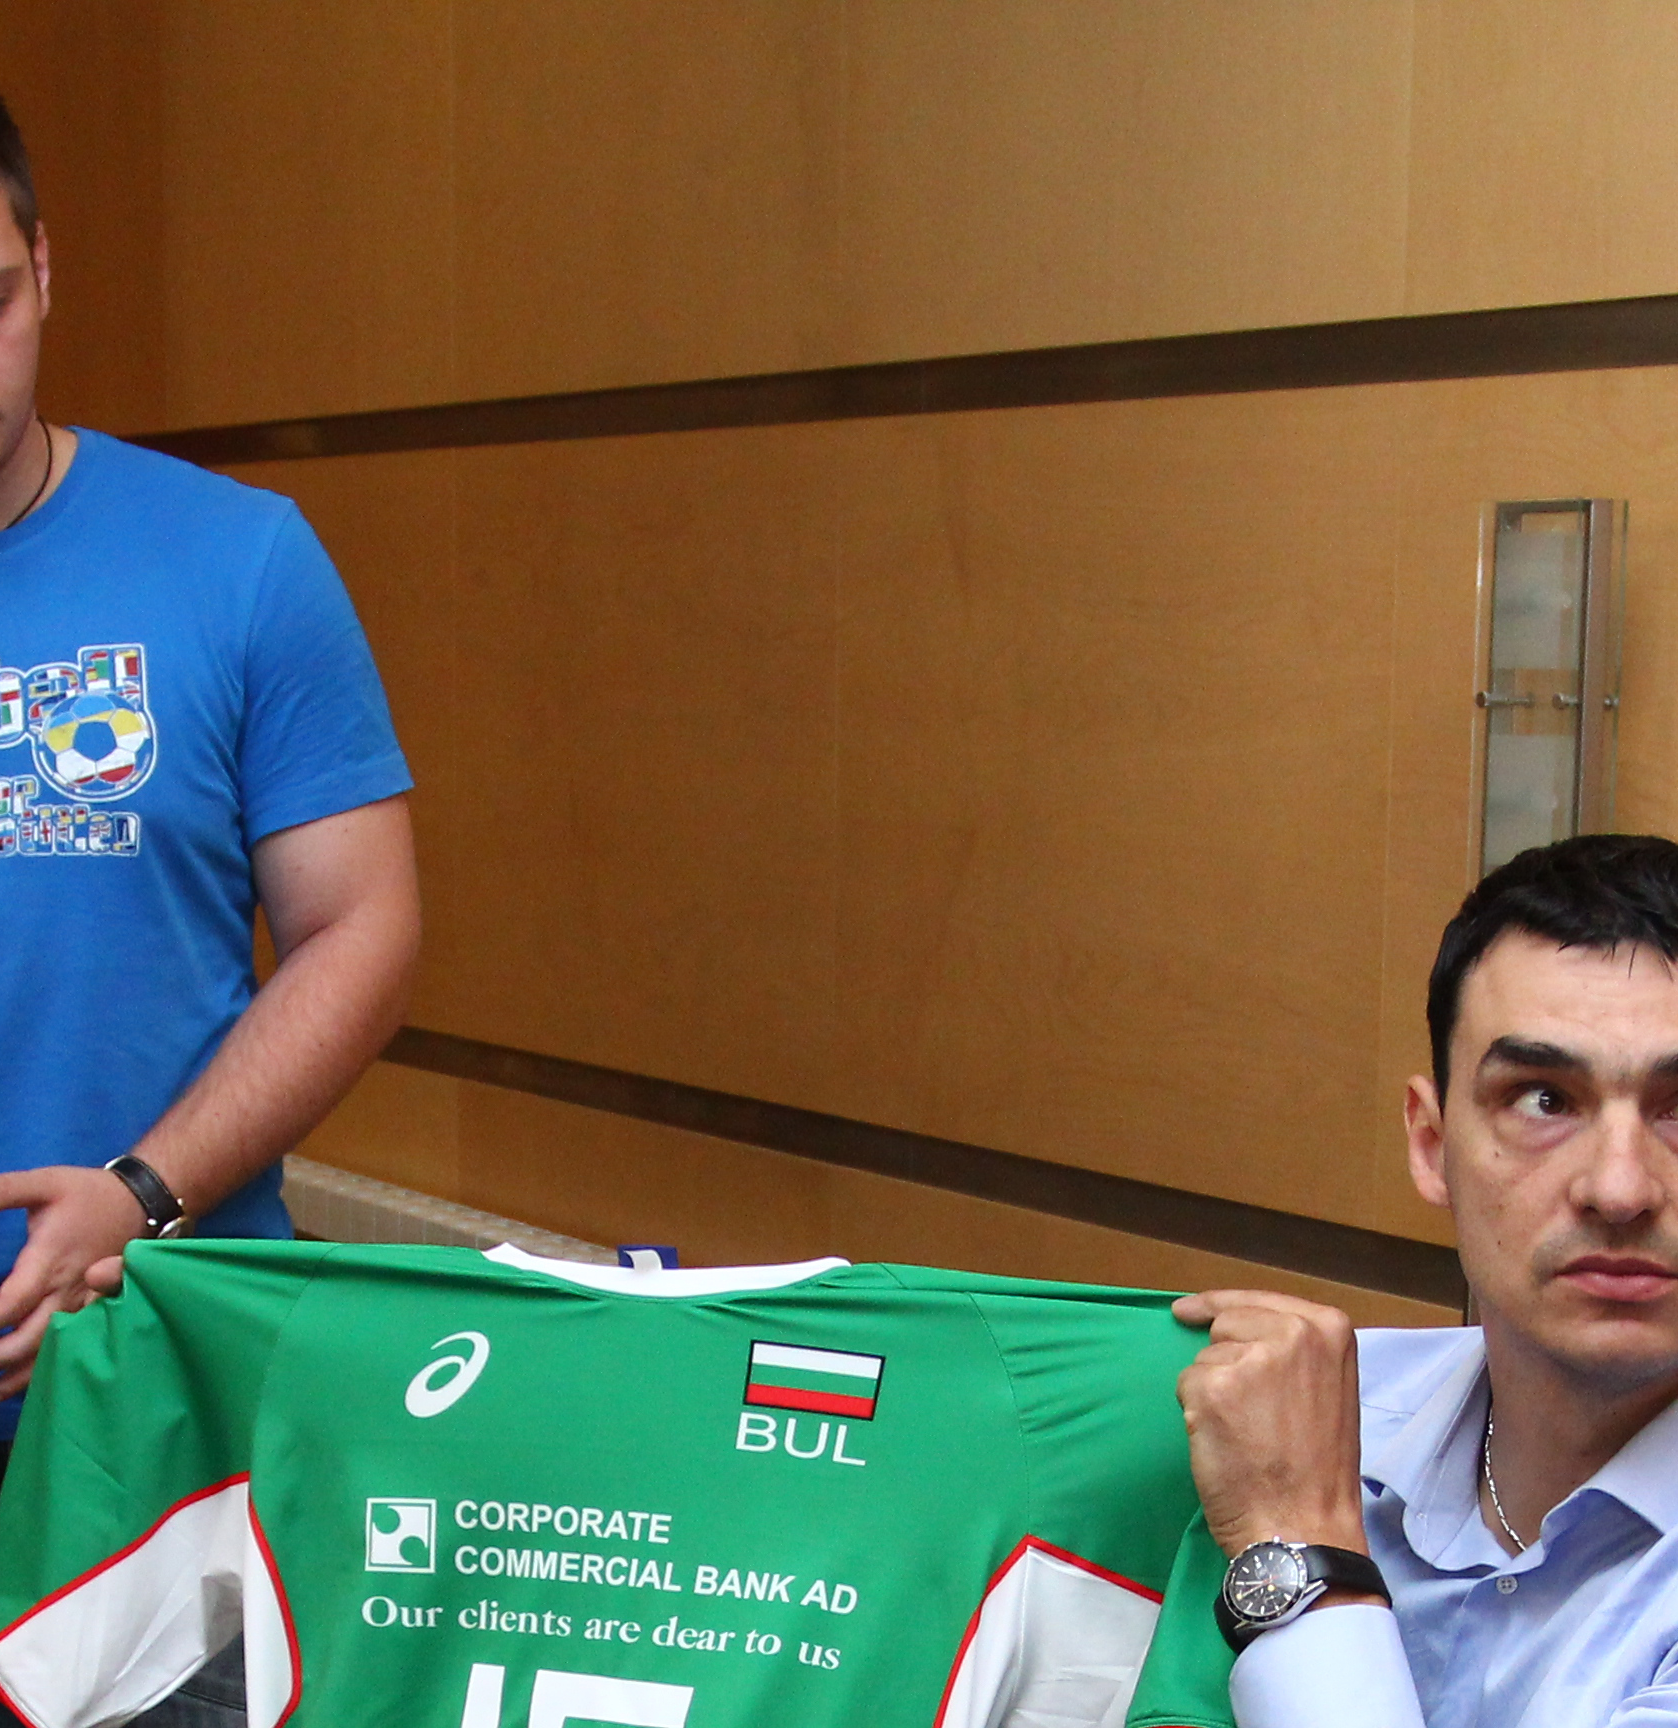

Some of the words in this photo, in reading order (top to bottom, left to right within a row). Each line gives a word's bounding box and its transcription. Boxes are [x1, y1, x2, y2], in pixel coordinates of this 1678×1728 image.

[735, 1412, 867, 1466] BUL
[454, 1499, 673, 1545] CORPORATE
[454, 1545, 682, 1593] COMMERCIAL
[694, 1565, 797, 1604] BANK
[800, 1579, 859, 1615] AD
[361, 1596, 444, 1628] Our
[457, 1599, 572, 1638] clients
[583, 1617, 642, 1644] are
[651, 1615, 736, 1653] dear
[744, 1629, 783, 1656] to
[797, 1641, 842, 1671] us
